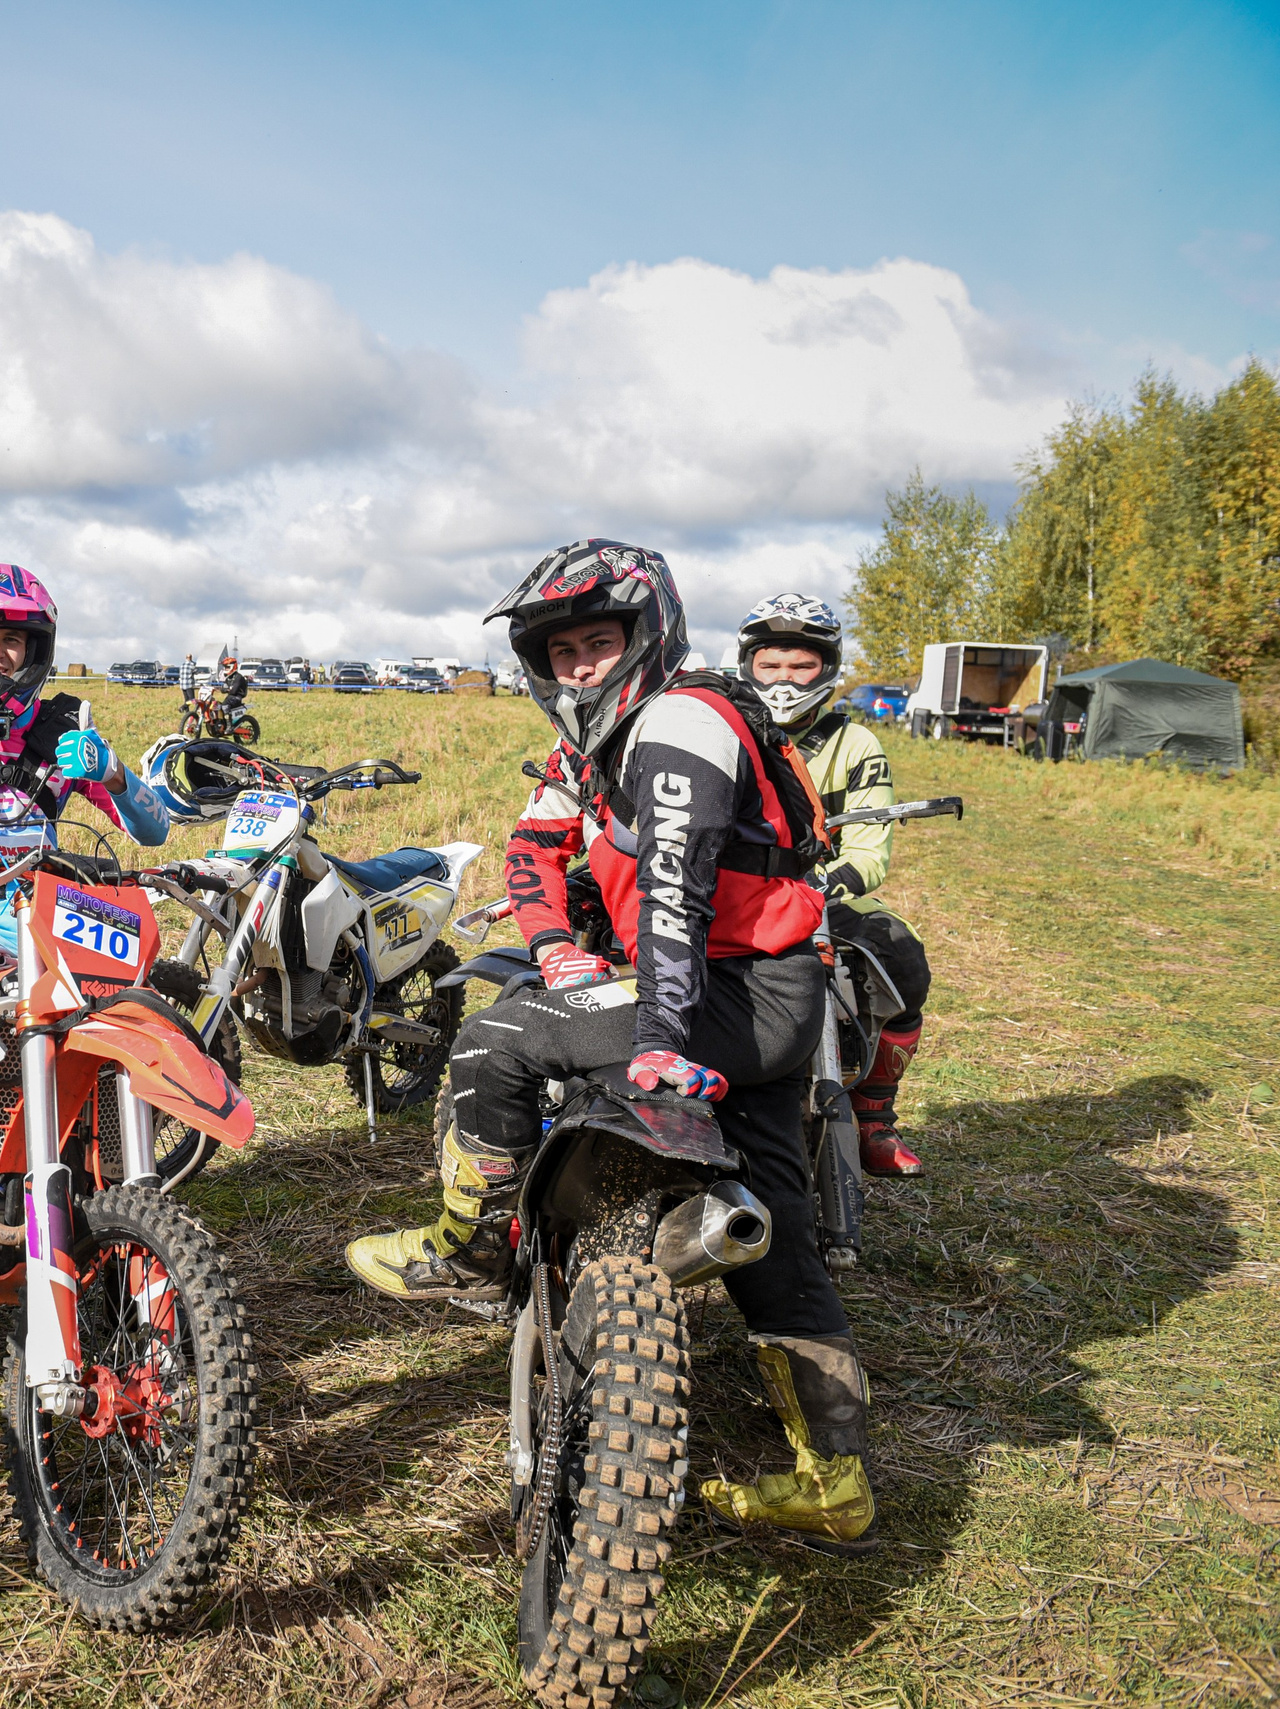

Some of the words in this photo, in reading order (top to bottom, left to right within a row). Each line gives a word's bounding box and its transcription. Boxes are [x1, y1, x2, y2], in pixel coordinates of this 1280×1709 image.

[553, 562, 610, 594] AIROH
[528, 600, 566, 621] AIROH
[593, 707, 607, 738] AIROH
[858, 757, 893, 789] FO
[133, 784, 170, 830] FXR
[230, 817, 267, 837] 238
[649, 771, 693, 947] RACING
[506, 852, 553, 914] FOX
[57, 884, 139, 928] MOTOFEST
[62, 912, 130, 960] 210
[384, 913, 408, 941] 477
